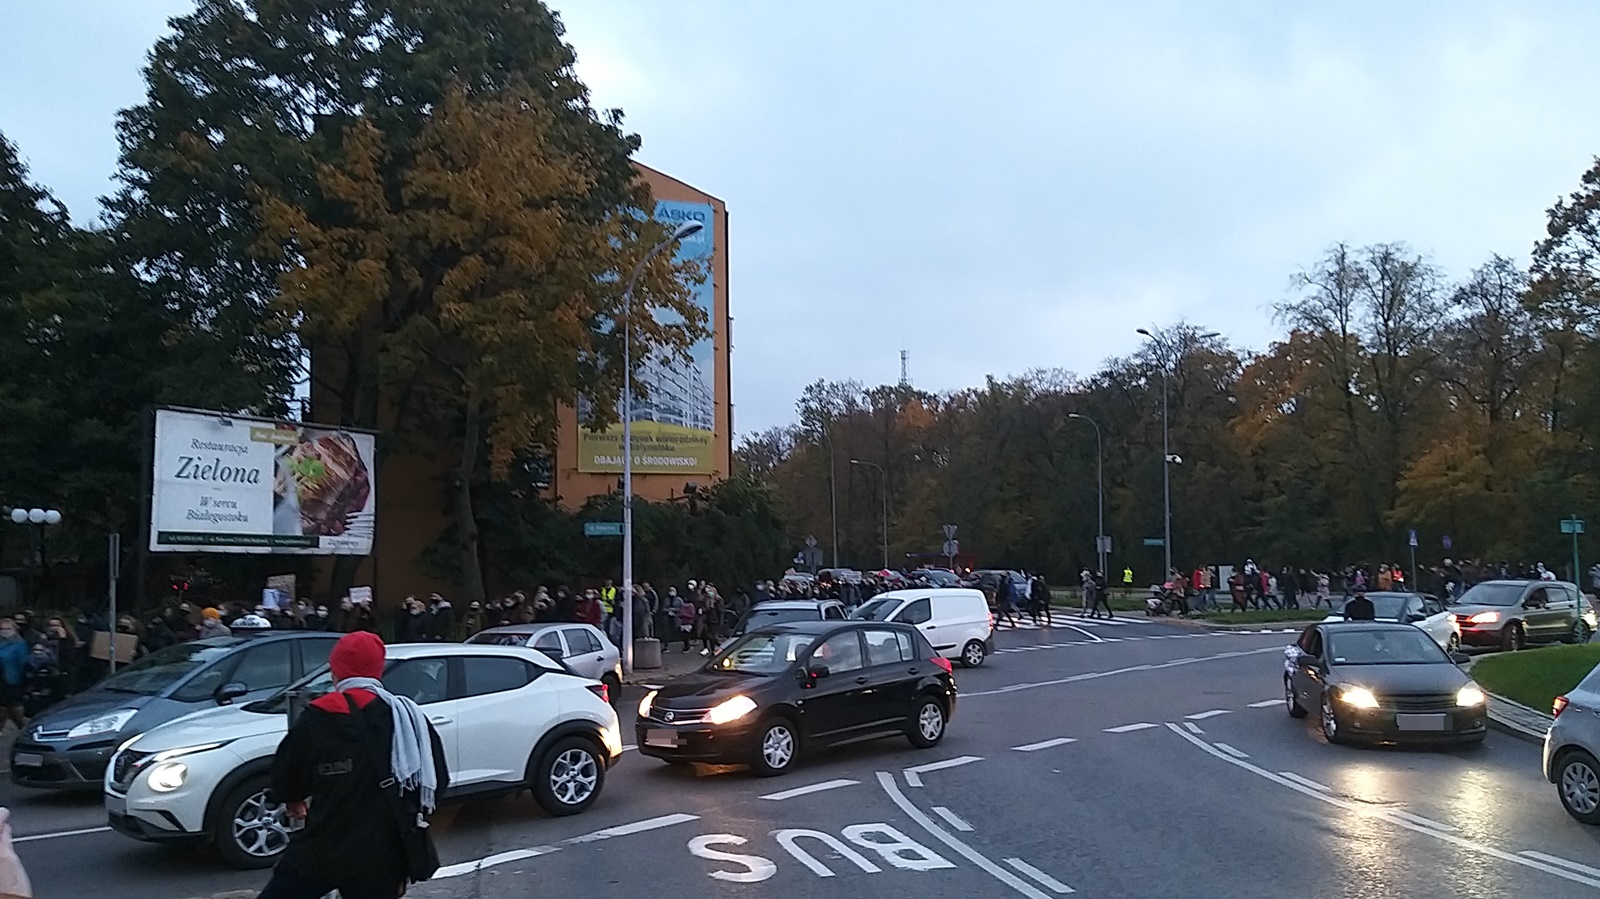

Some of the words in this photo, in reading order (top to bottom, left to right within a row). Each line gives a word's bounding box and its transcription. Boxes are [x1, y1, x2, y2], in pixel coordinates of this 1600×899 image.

[190, 438, 249, 456] Restauracja
[174, 456, 260, 484] Zielona
[593, 455, 633, 467] DBAJĄC
[634, 456, 641, 466] O
[642, 454, 698, 467] ŚRODOWISKO!
[687, 823, 957, 882] BUS
